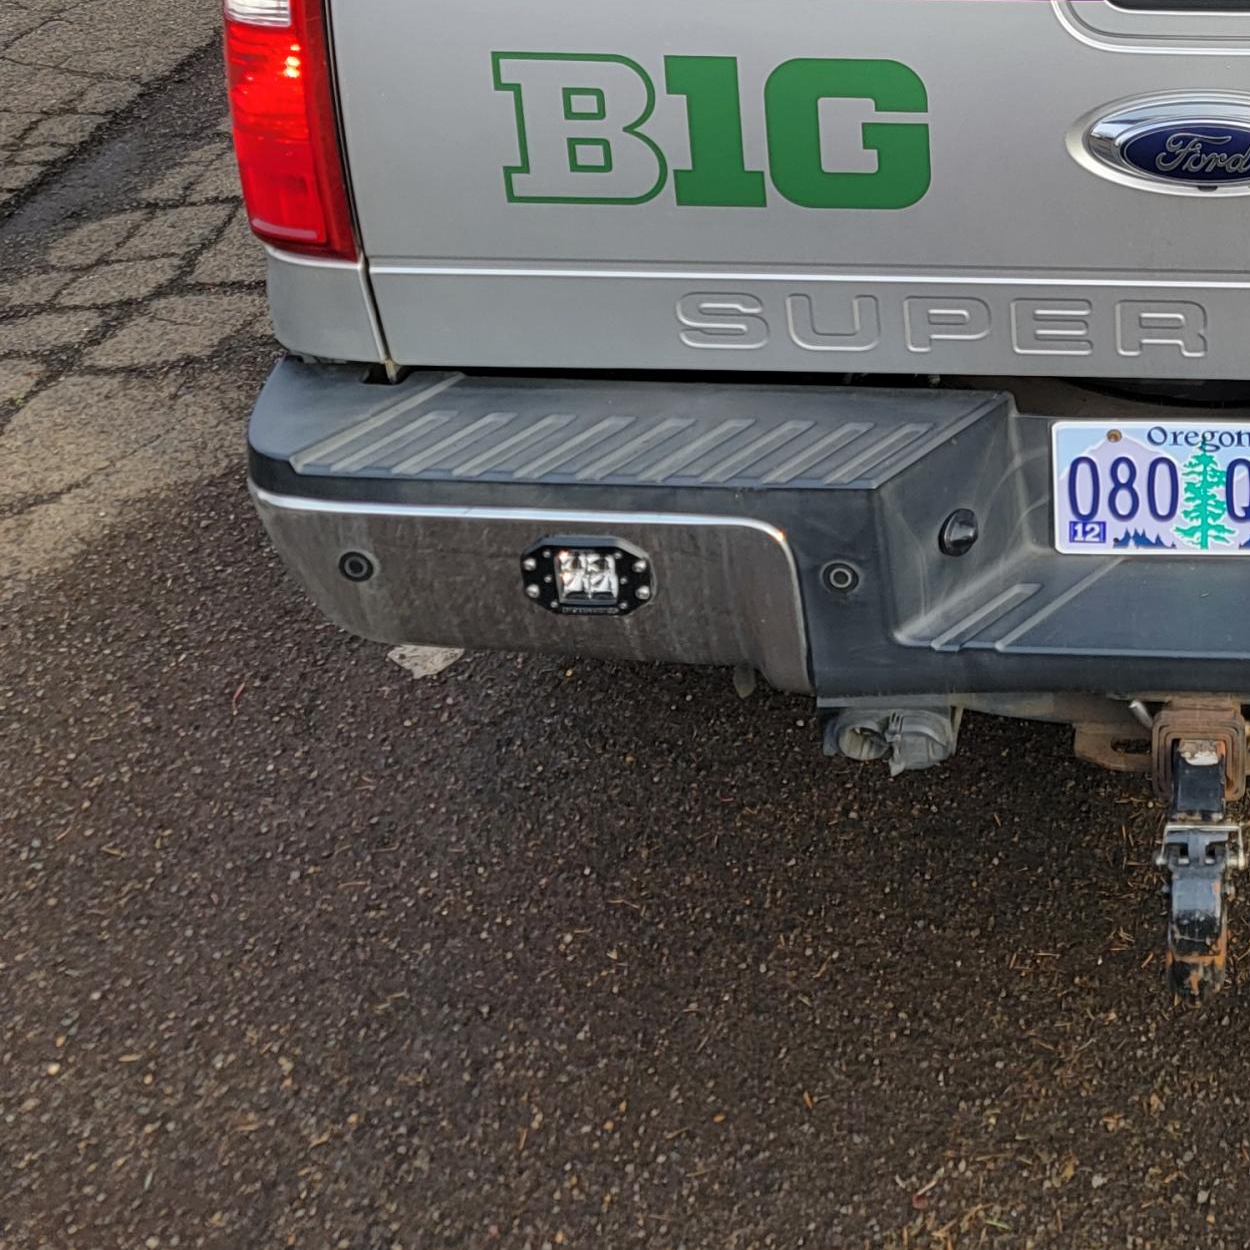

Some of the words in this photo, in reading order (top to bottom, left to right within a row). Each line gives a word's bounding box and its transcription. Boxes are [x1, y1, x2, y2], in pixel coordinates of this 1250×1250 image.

[676, 291, 1207, 357] SUPER
[1068, 456, 1179, 522] 080
[1074, 523, 1101, 542] 12
